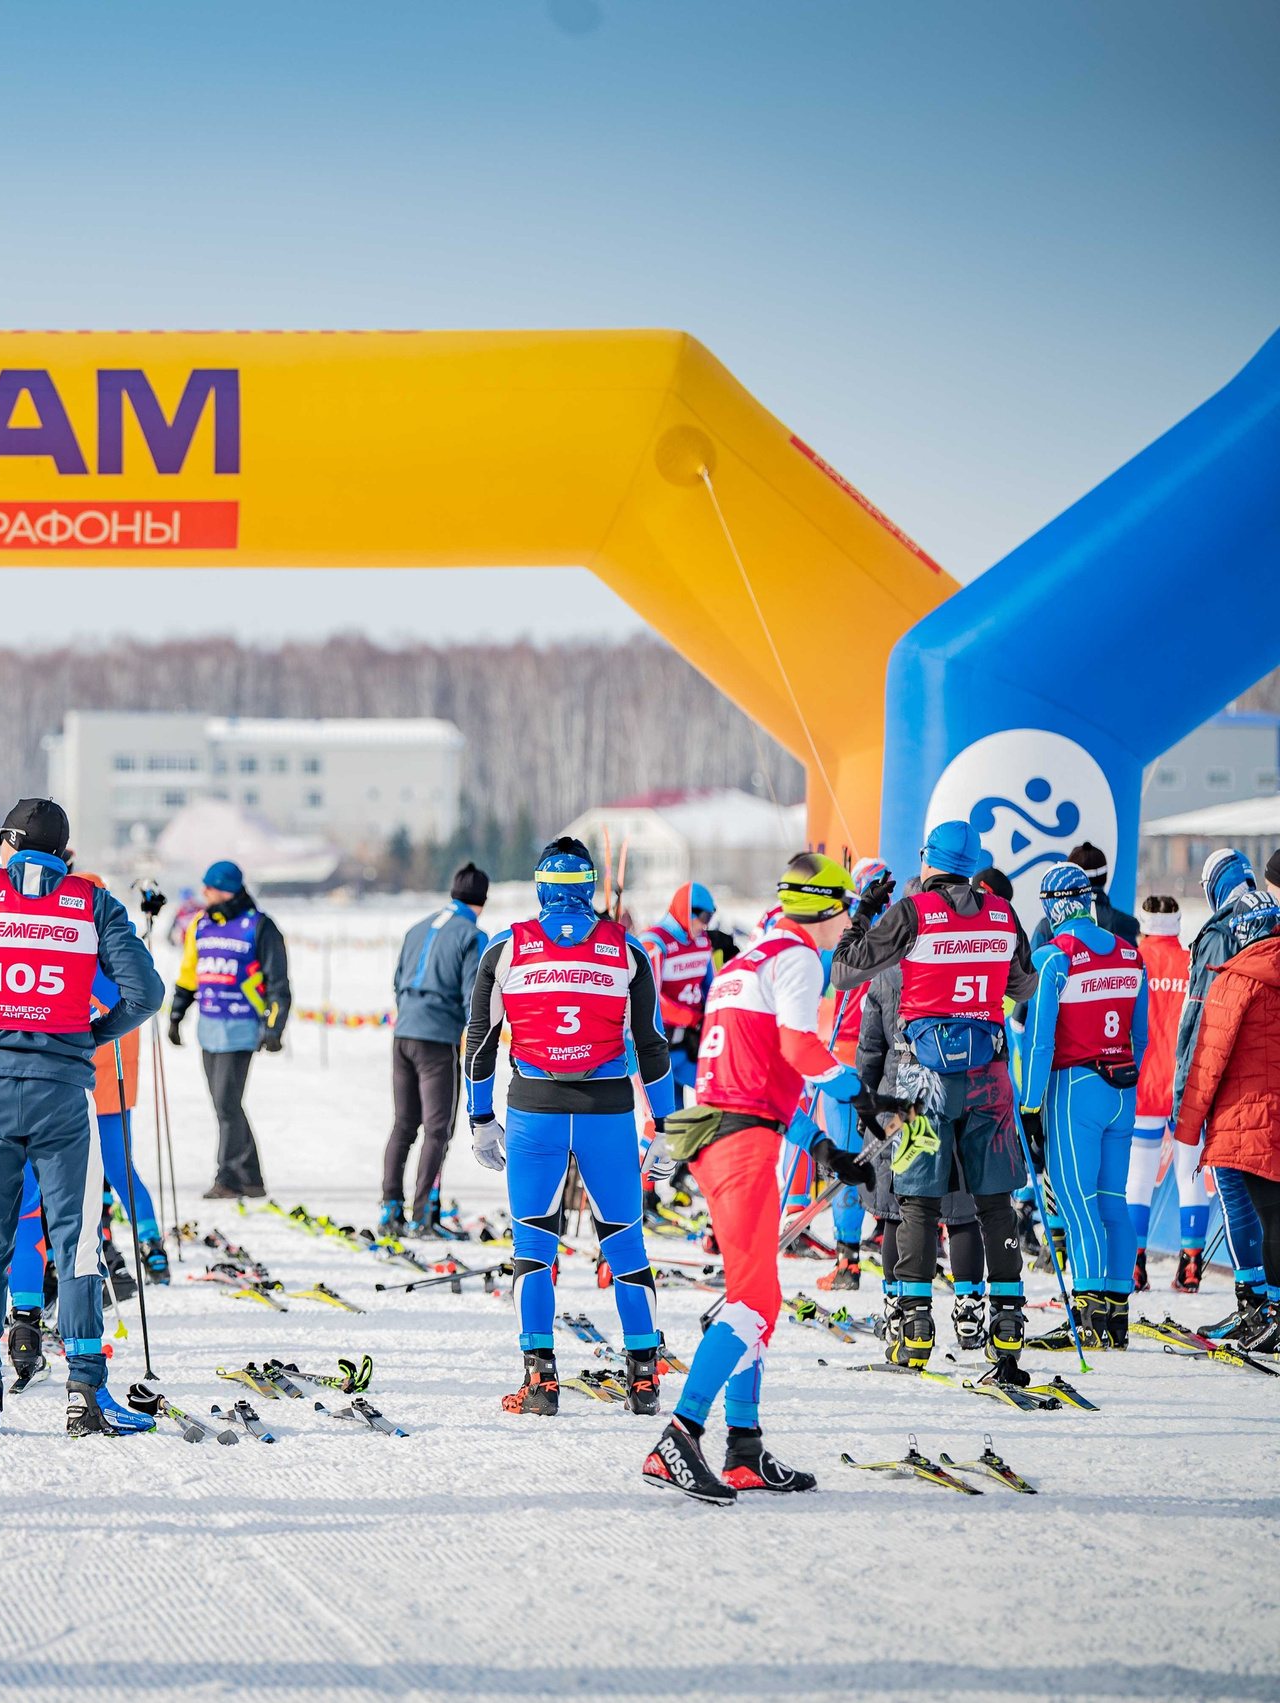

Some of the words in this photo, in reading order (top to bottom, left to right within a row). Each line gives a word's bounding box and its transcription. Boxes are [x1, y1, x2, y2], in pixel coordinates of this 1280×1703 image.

[924, 911, 948, 921] БАМ
[519, 940, 544, 951] БАМ
[933, 938, 1008, 955] ТЕМЕРСО
[951, 975, 989, 1003] 51
[1080, 975, 1138, 993] ТЕМЕРСО
[2, 1011, 47, 1021] АНГАРА
[556, 1006, 581, 1035] 3
[1104, 1010, 1120, 1038] 8
[546, 1044, 593, 1054] ТЕМЕРСО
[549, 1051, 590, 1061] АНГАРА
